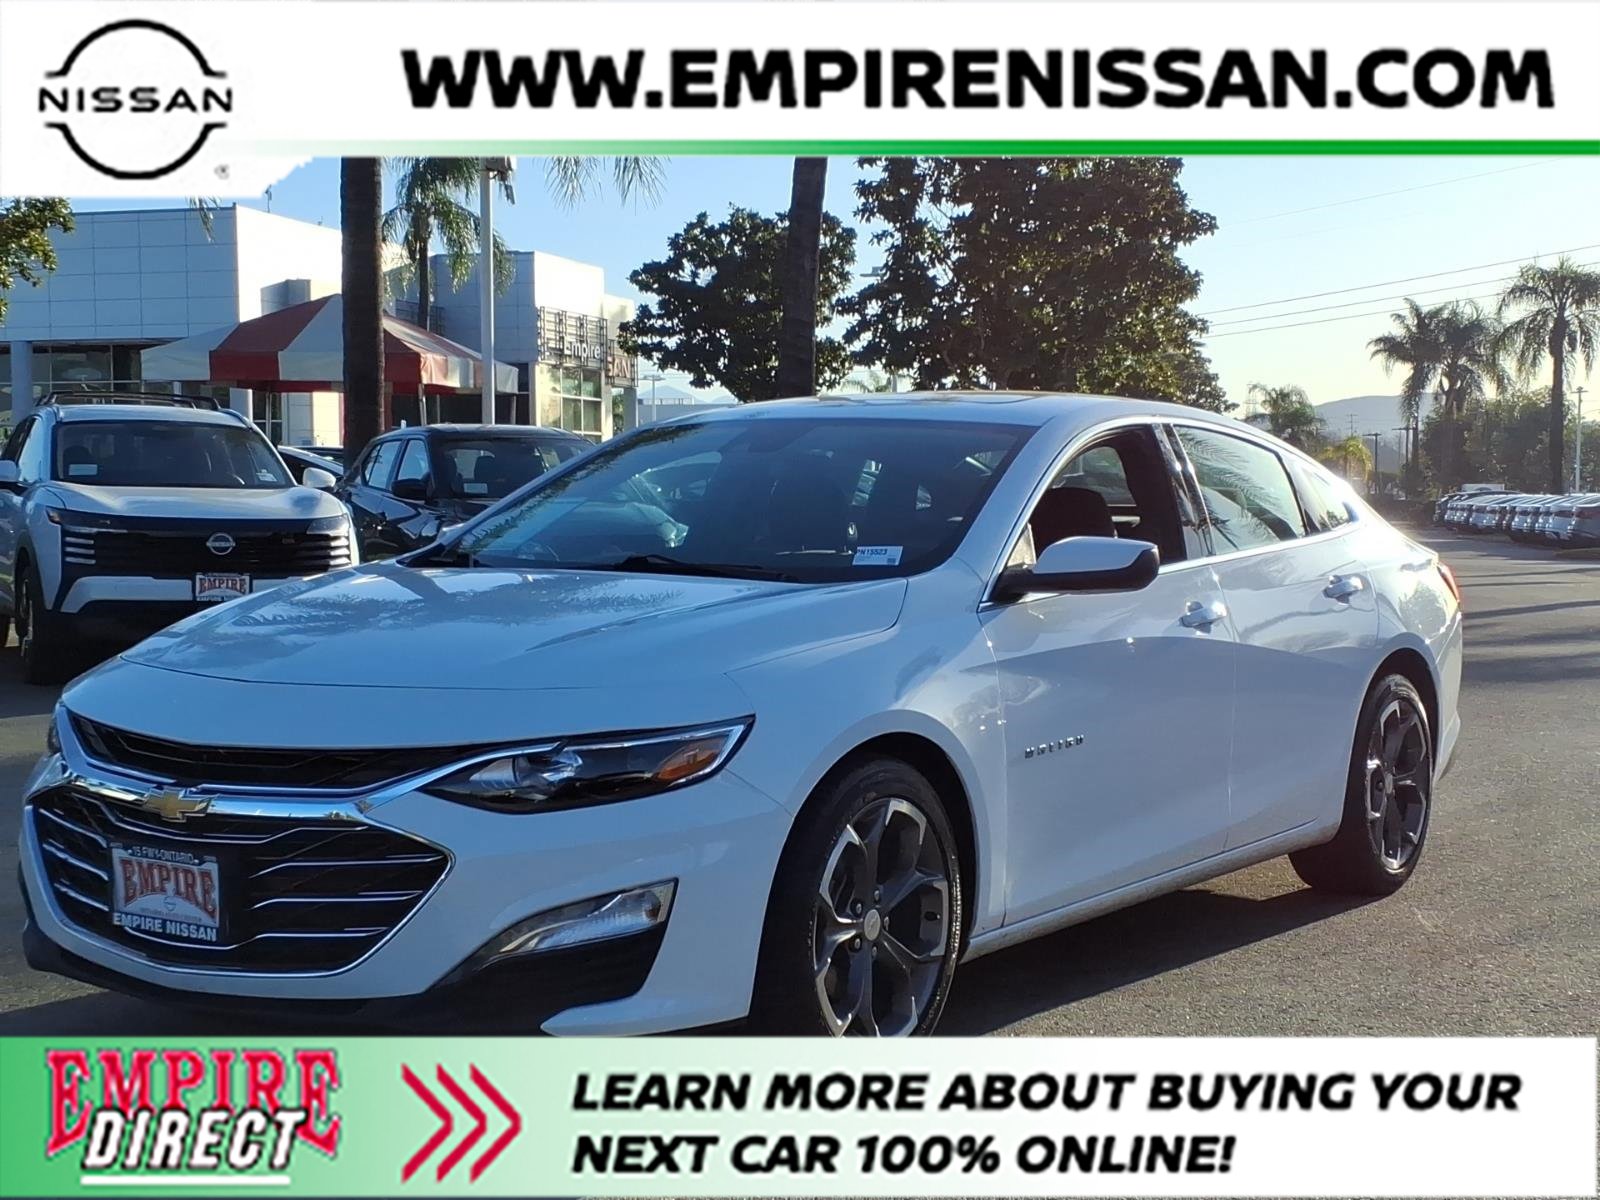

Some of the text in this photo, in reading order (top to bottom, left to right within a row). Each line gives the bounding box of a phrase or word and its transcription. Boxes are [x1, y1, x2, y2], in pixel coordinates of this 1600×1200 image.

[563, 336, 601, 361] Empire
[198, 577, 246, 595] EMPIRE
[120, 858, 217, 923] EMPIRE
[112, 912, 163, 933] EMPIRE
[166, 920, 217, 942] NISSAN
